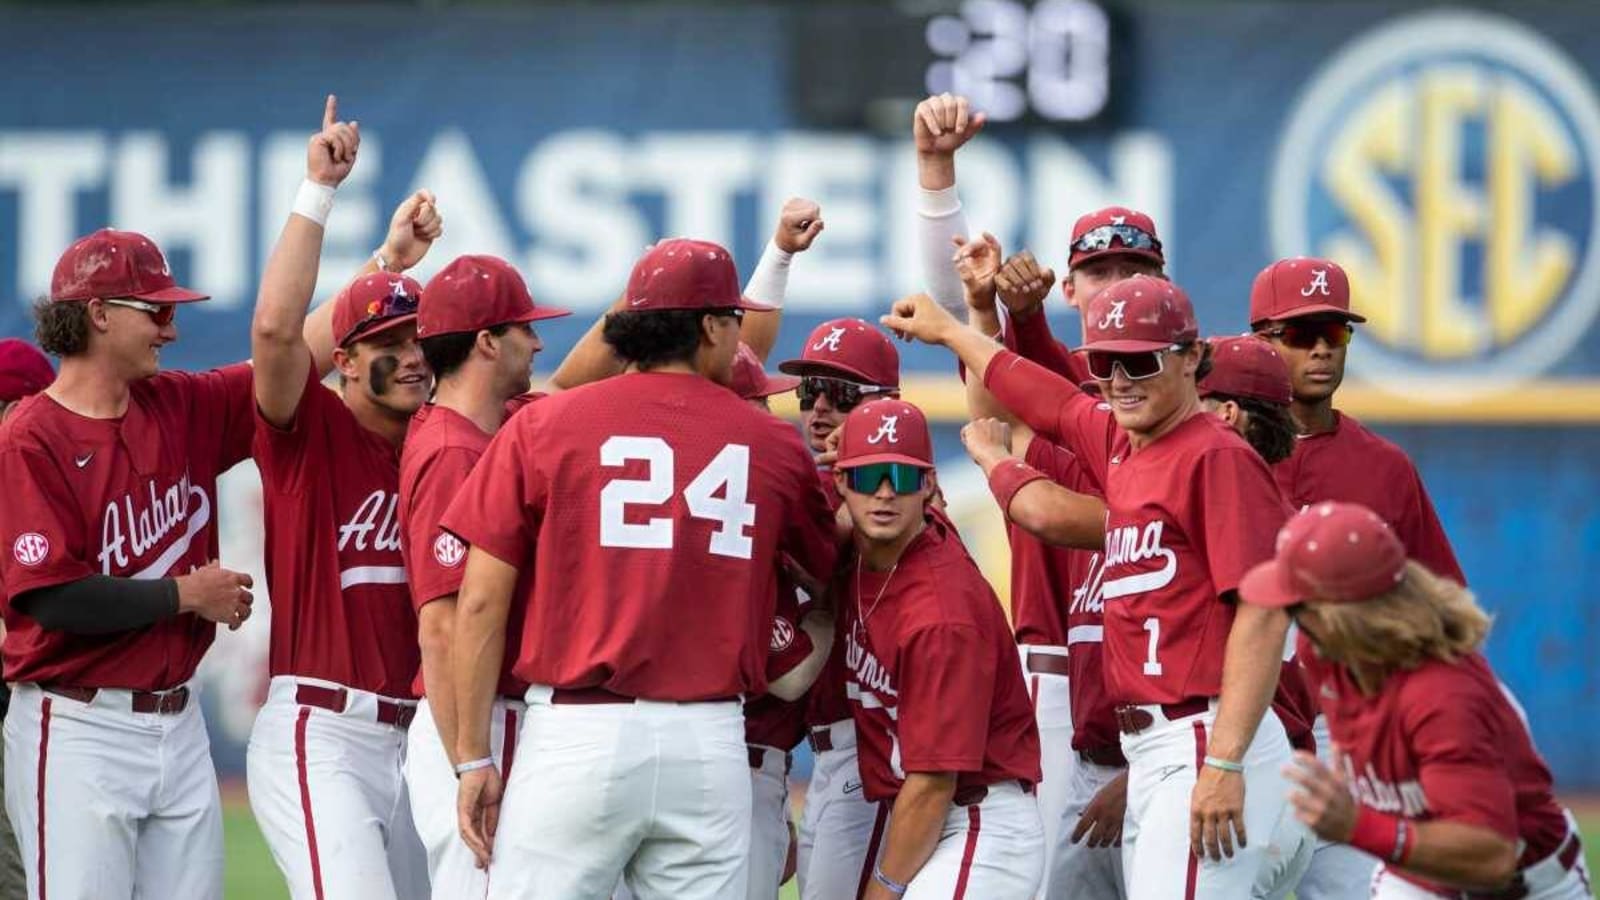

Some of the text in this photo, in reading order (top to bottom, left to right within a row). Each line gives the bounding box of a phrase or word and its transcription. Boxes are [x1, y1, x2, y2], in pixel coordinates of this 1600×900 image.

[1322, 66, 1578, 358] SEC
[1301, 270, 1329, 296] A
[1099, 301, 1127, 329] A
[813, 326, 846, 351] A
[867, 415, 898, 443] A
[600, 436, 756, 559] 24
[17, 536, 46, 563] SEC
[436, 533, 463, 563] SEC
[1143, 618, 1162, 675] 1
